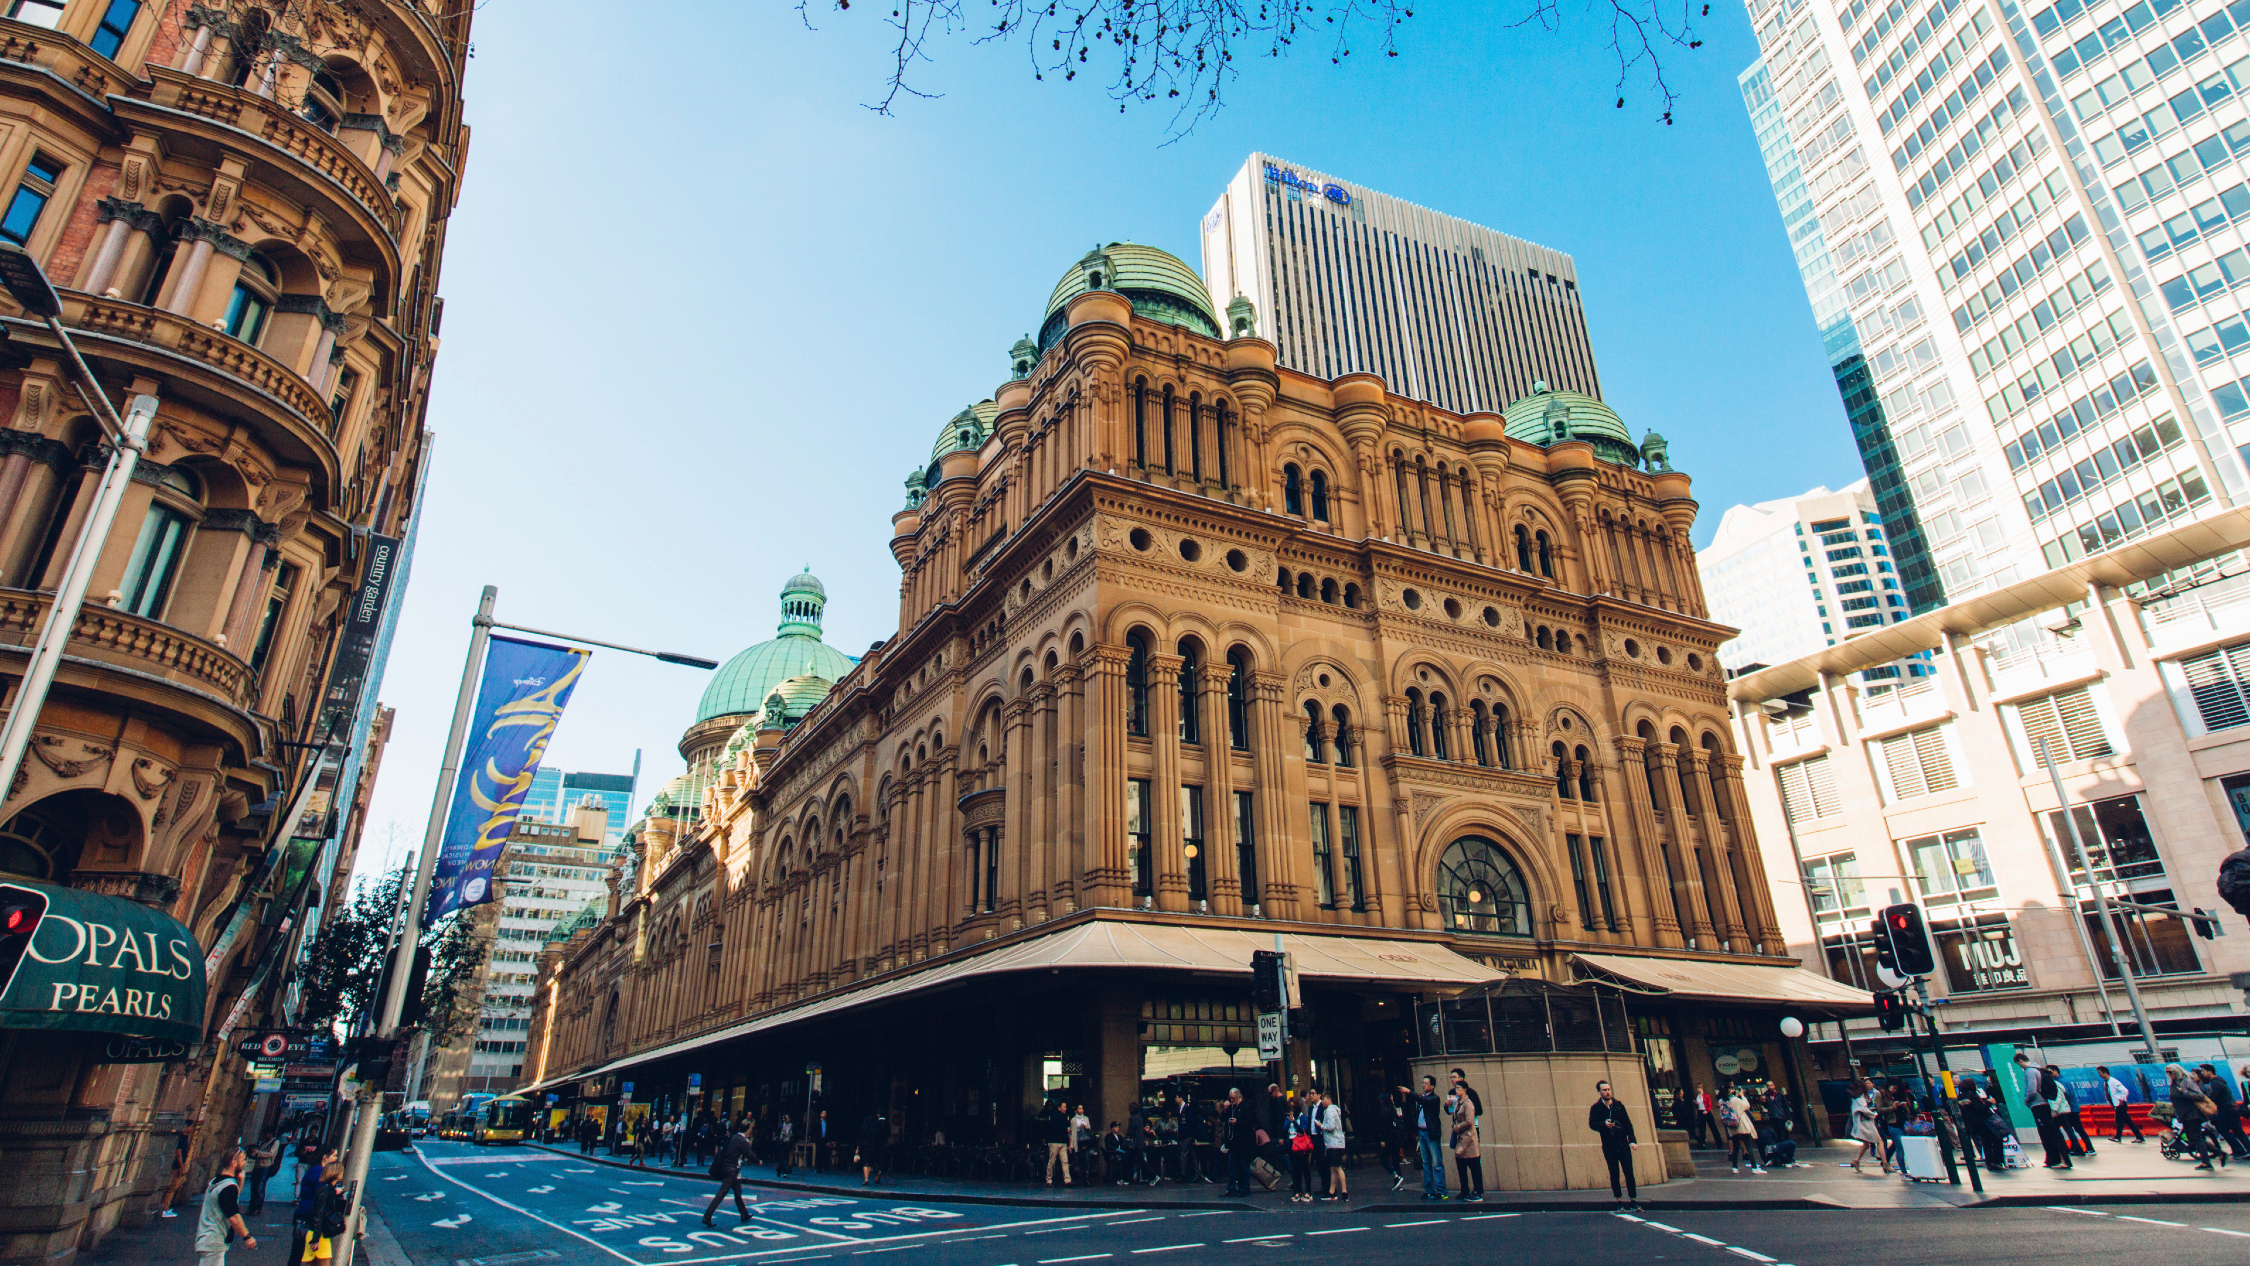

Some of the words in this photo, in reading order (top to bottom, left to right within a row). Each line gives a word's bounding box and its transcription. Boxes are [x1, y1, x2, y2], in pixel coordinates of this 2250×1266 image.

[1266, 165, 1319, 193] Hilton
[368, 545, 390, 586] country
[360, 586, 379, 623] garden
[28, 914, 192, 980] OPALS
[1958, 937, 2021, 970] MUJ
[1491, 957, 1538, 970] VICORIA
[48, 982, 172, 1020] PEARLS
[1261, 1017, 1277, 1028] ONE
[1260, 1031, 1278, 1042] WAY
[572, 1210, 717, 1232] LANE
[809, 1207, 965, 1229] BUS
[638, 1225, 800, 1252] BUS
